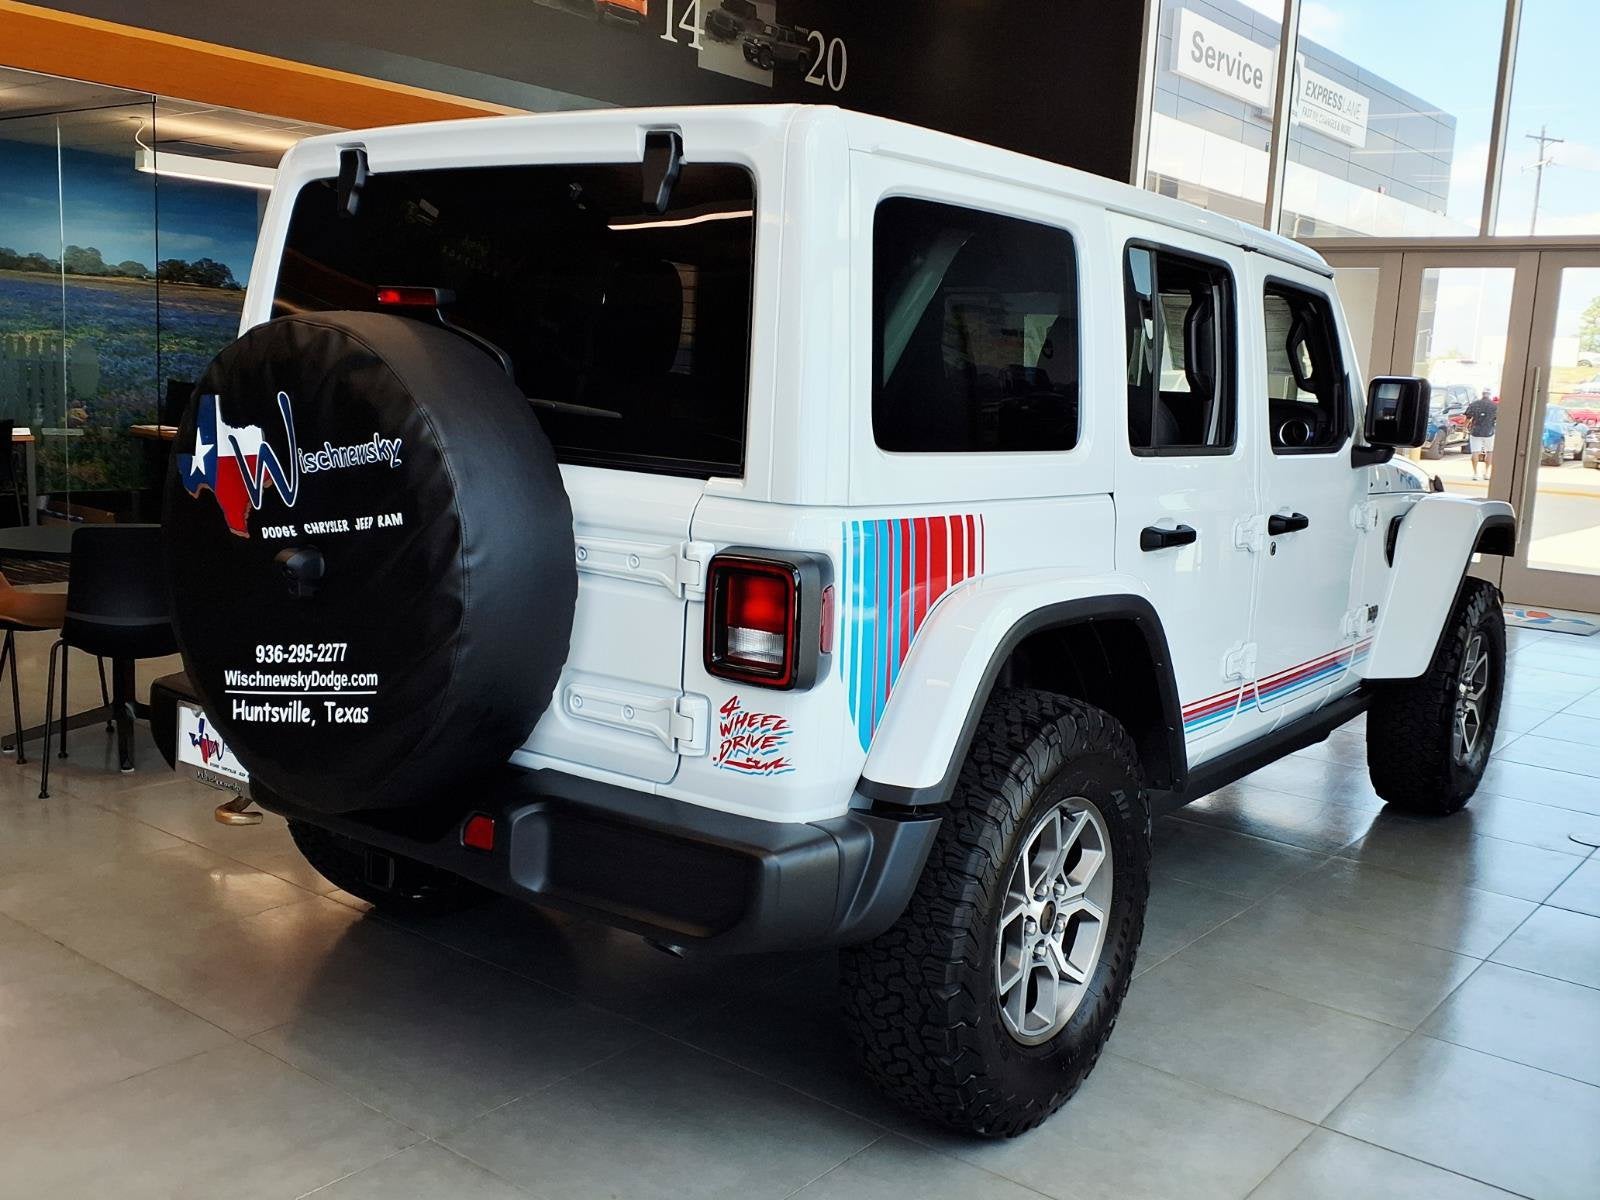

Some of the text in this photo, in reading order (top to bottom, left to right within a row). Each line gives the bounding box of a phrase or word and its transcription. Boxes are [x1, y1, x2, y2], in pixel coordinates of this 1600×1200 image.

[804, 30, 848, 92] 20
[1190, 30, 1264, 90] Service
[228, 391, 402, 510] Wischnewsky
[262, 512, 404, 539] DODGE CHRYSLER JEEP RAM
[255, 643, 348, 663] 936-295-2277
[224, 669, 378, 691] WischnewskyDodge.com
[232, 699, 369, 726] Huntsville, Texas
[720, 695, 741, 719] 4
[719, 733, 784, 763] DRIVE
